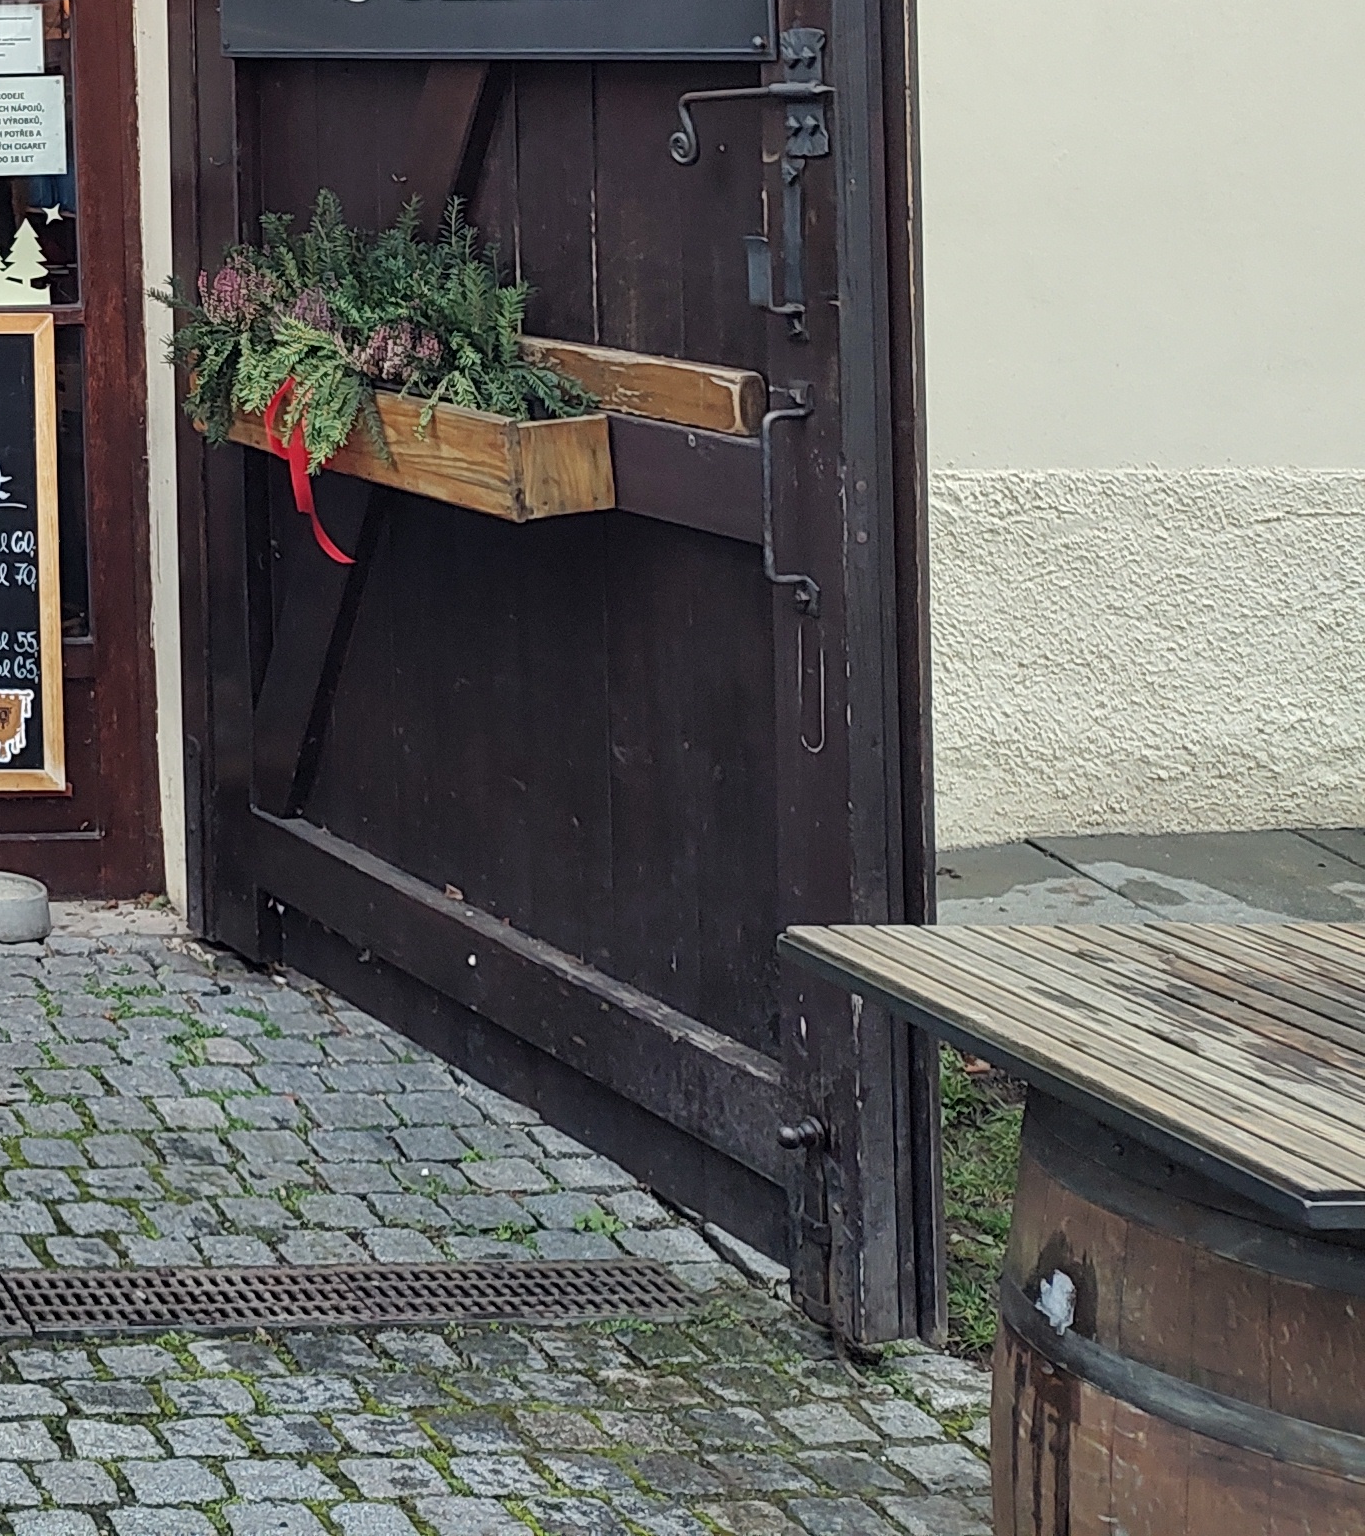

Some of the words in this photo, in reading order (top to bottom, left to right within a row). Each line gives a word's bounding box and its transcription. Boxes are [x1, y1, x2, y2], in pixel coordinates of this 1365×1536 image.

[11, 103, 45, 113] NÁPOJŮ,
[4, 129, 34, 138] POTŘEB
[14, 142, 46, 150] CIGARET
[10, 155, 19, 163] 18
